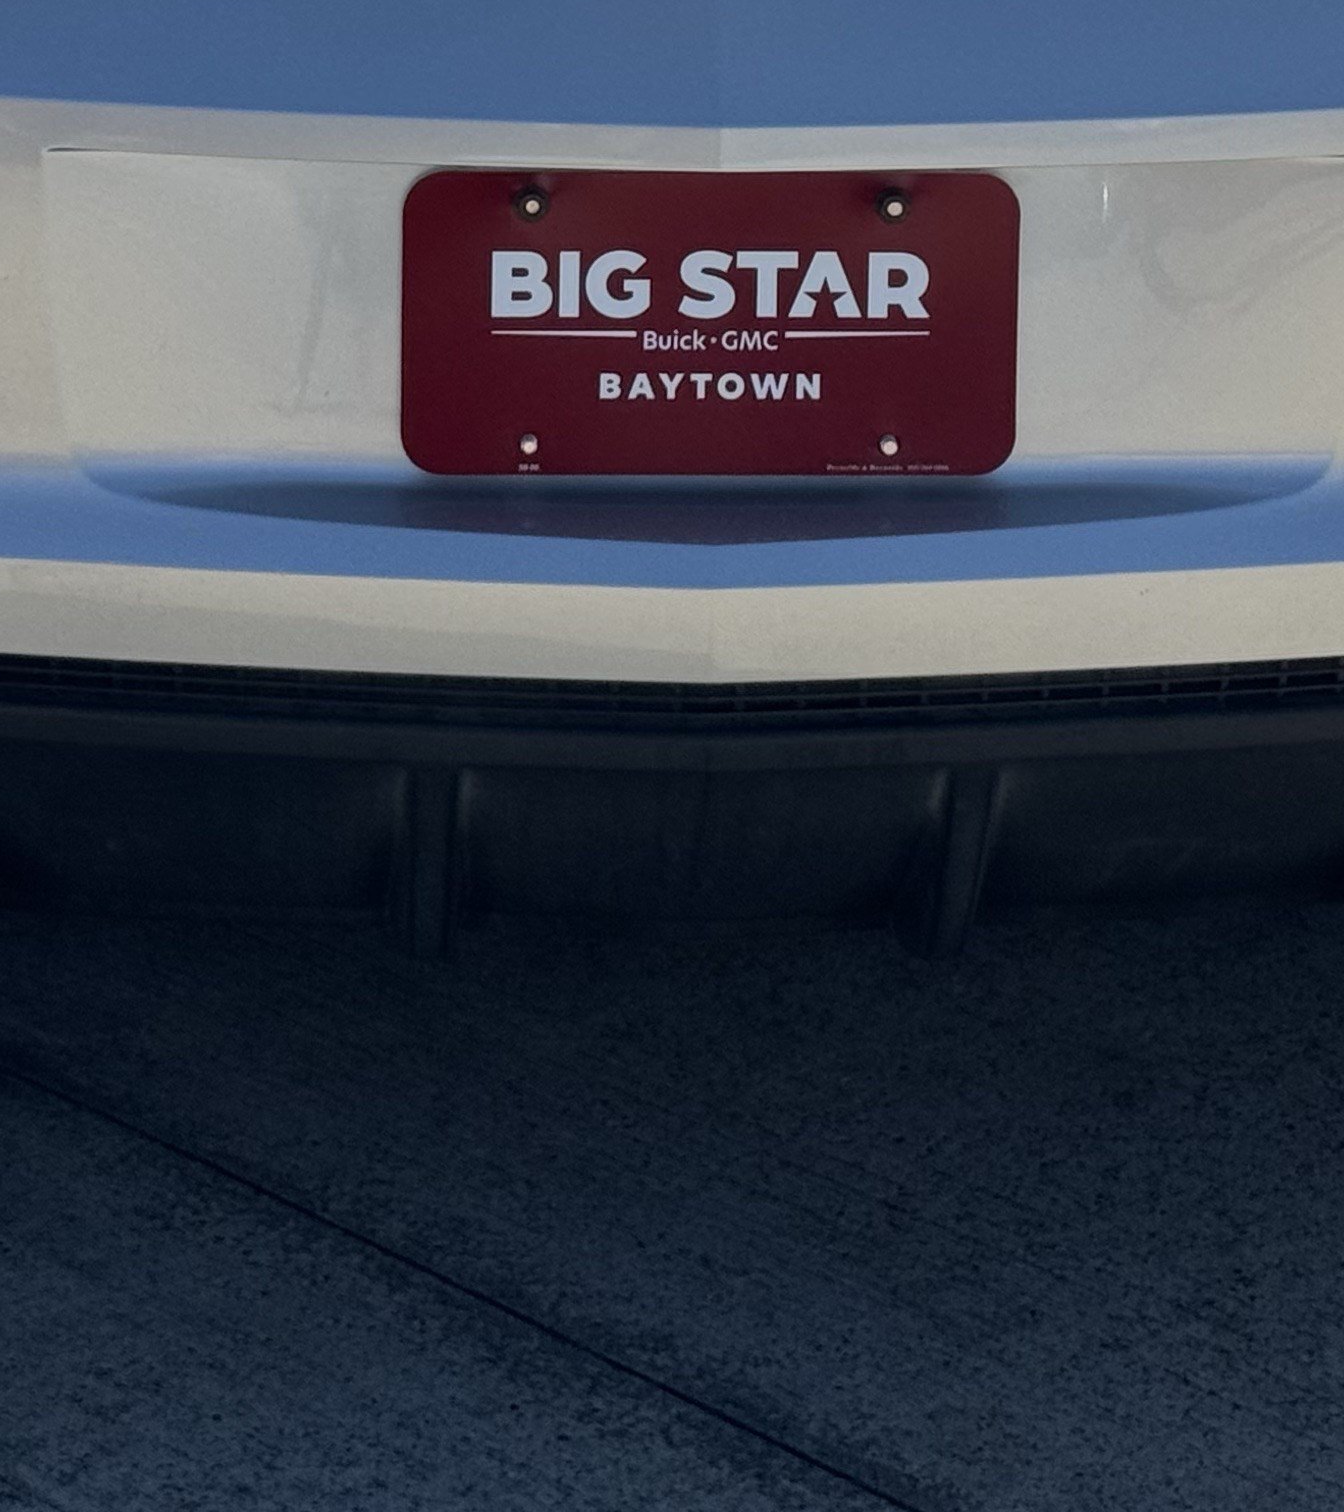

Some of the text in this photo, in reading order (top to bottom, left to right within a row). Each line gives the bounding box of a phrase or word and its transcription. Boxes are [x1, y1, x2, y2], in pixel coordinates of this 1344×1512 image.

[491, 250, 931, 319] BIG STAR
[599, 372, 822, 401] BAYTOWN
